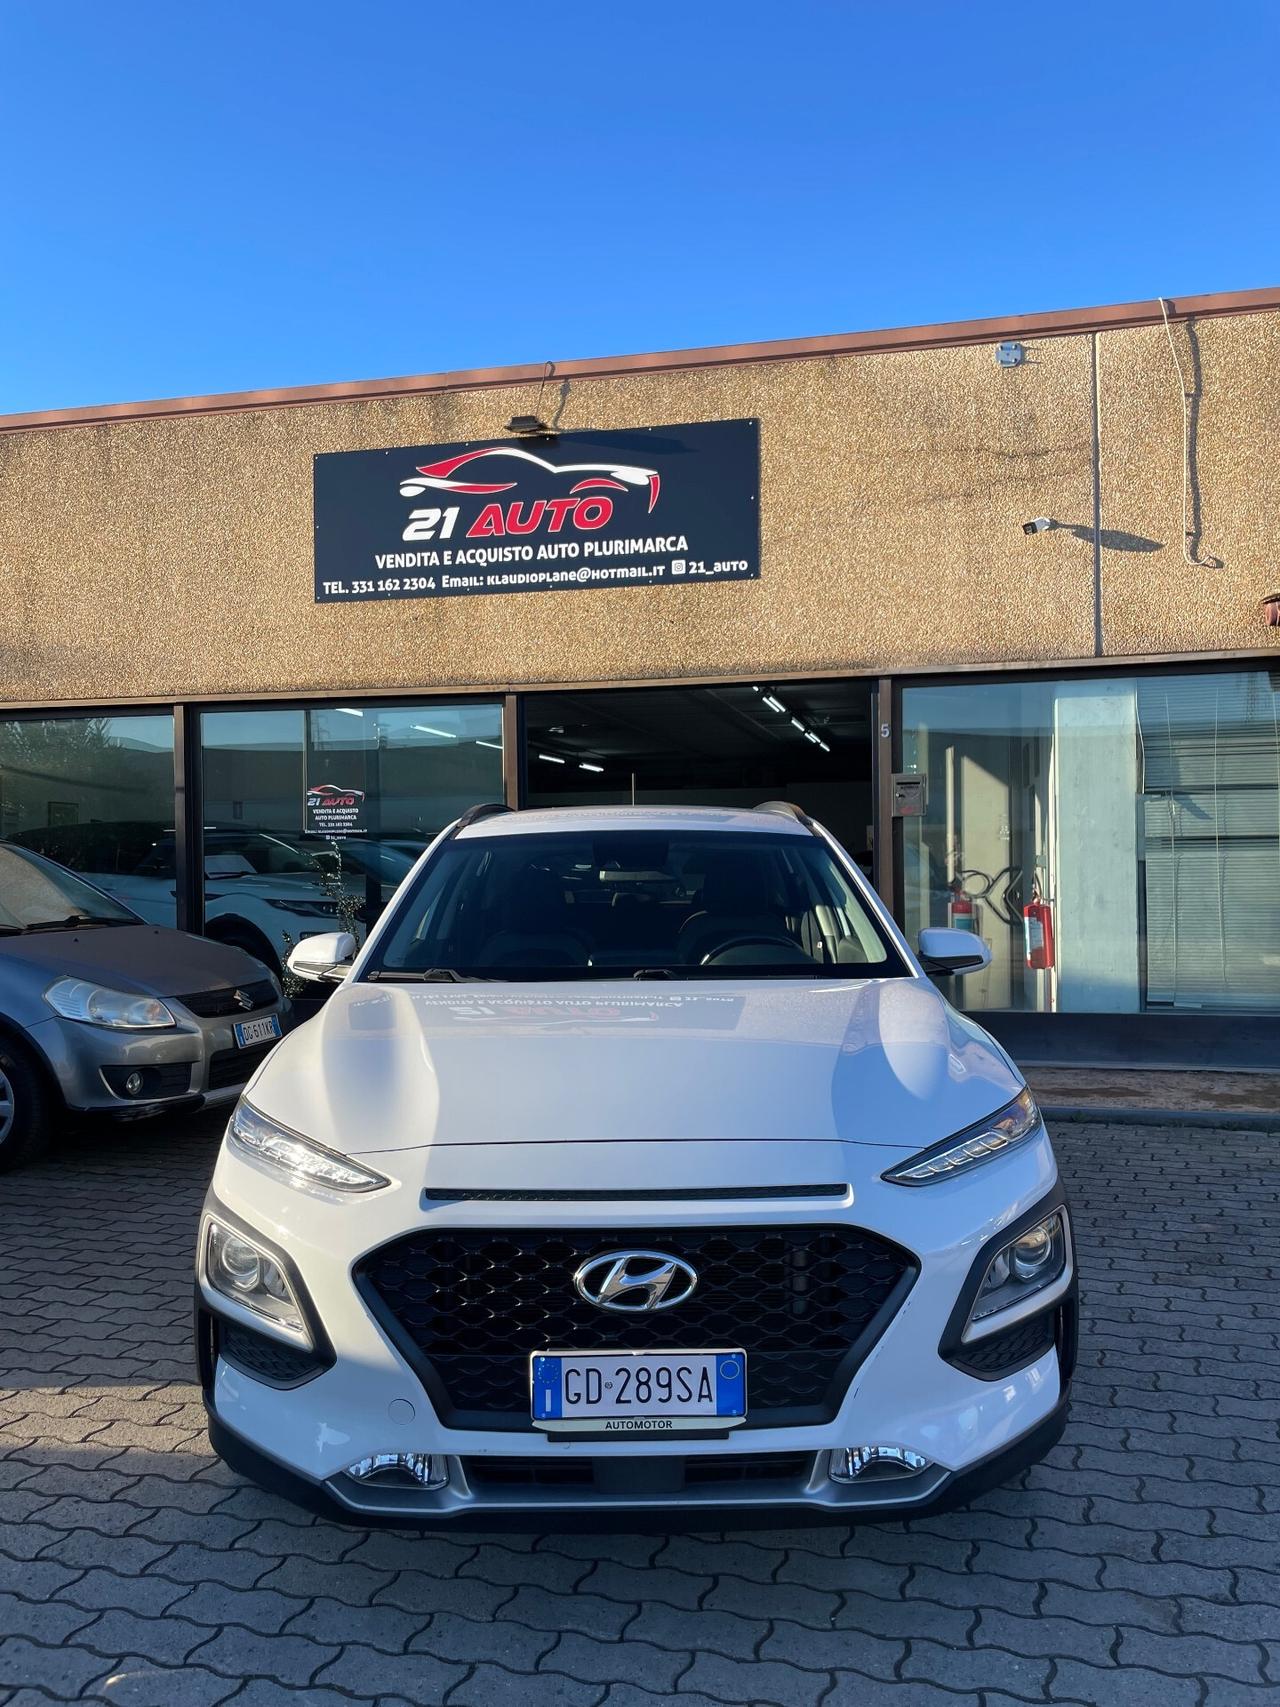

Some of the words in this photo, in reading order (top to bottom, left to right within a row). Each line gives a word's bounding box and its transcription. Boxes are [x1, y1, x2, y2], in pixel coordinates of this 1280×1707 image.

[402, 506, 460, 541] 21
[466, 496, 613, 538] AUTO
[375, 552, 440, 569] VENDITA
[443, 551, 452, 565] E
[456, 546, 533, 567] ACQUISTO
[537, 542, 579, 560] AUTO
[584, 536, 688, 557] PLURIMARCA
[323, 581, 349, 594] TEL.
[352, 580, 375, 594] 331
[378, 578, 400, 592] 162
[403, 577, 436, 591] 2304
[881, 724, 889, 737] 5
[307, 797, 320, 806] 21
[605, 1420, 673, 1430] AUTOMOTOR
